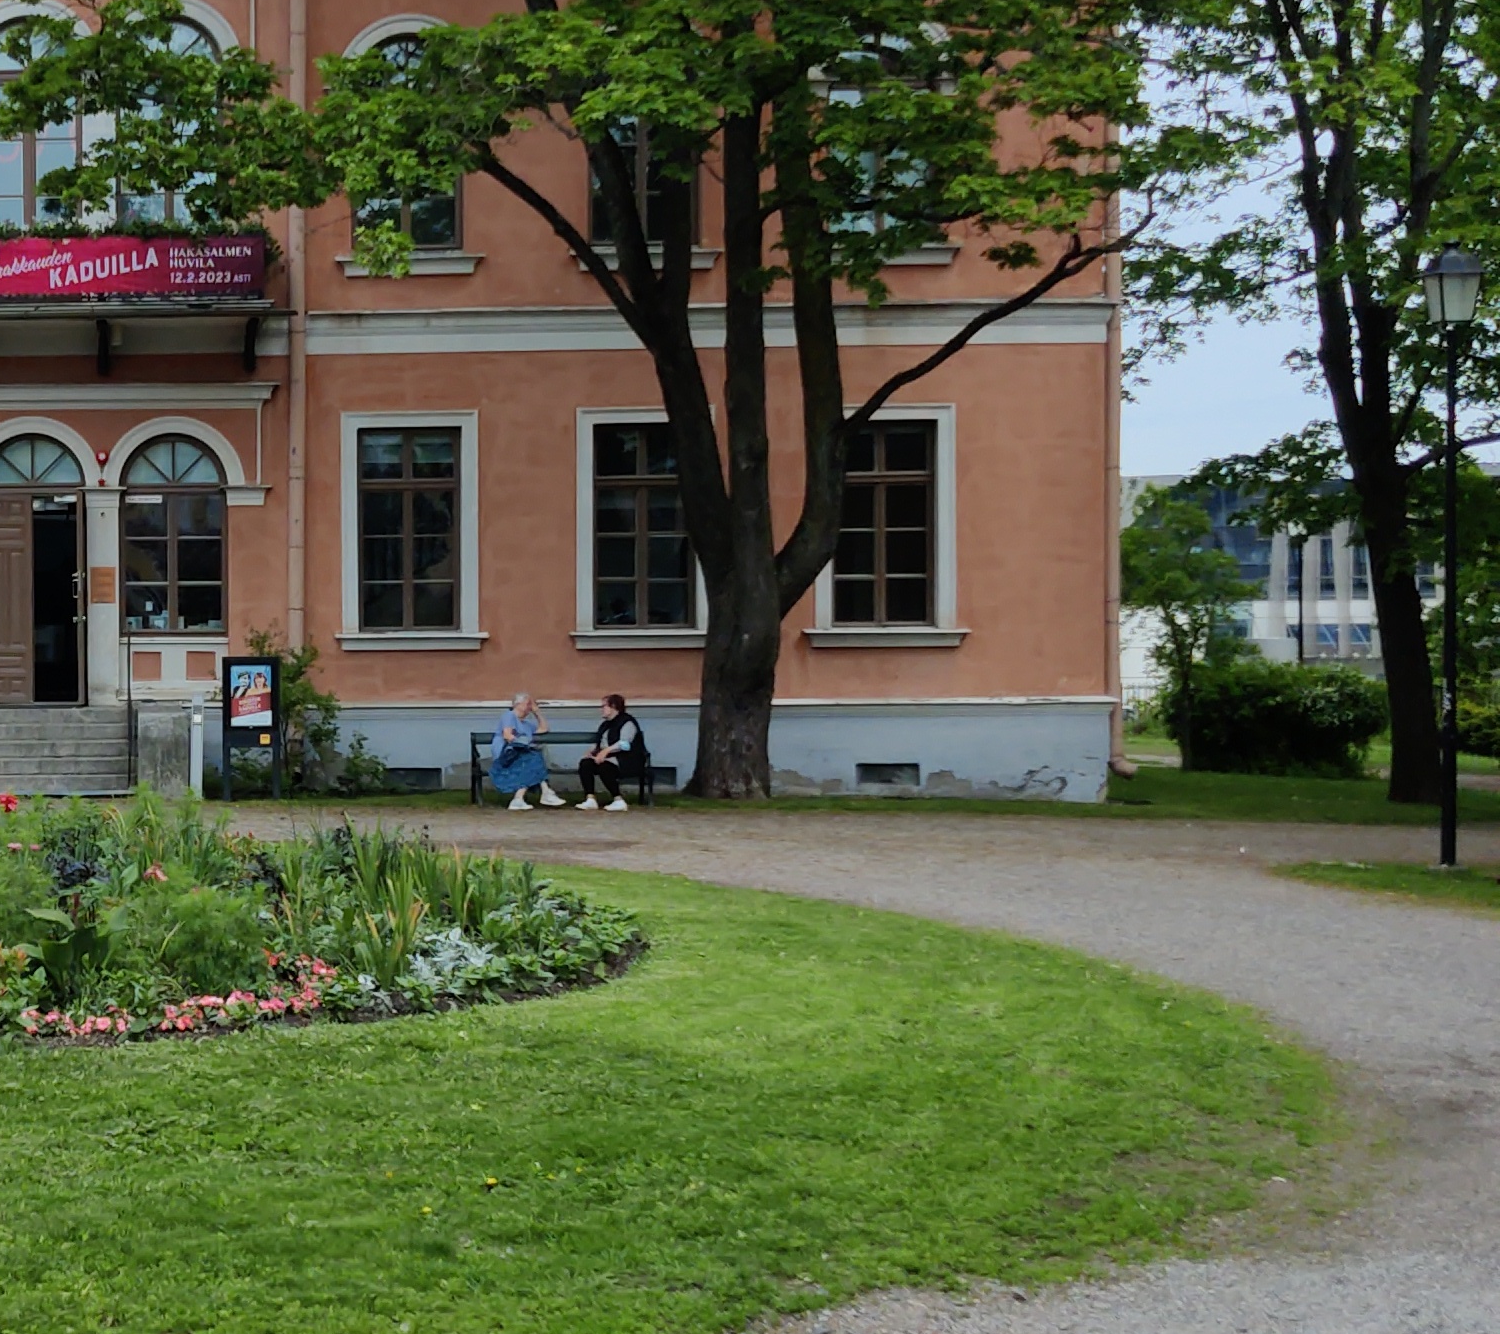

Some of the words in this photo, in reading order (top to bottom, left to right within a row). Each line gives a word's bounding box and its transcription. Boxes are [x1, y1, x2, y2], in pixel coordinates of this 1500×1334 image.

[169, 246, 252, 258] HAKASALMEN
[50, 247, 159, 289] KADUILLA
[169, 257, 215, 268] HUVILA
[170, 271, 231, 284] 12.2.2023
[233, 274, 252, 283] ASTI
